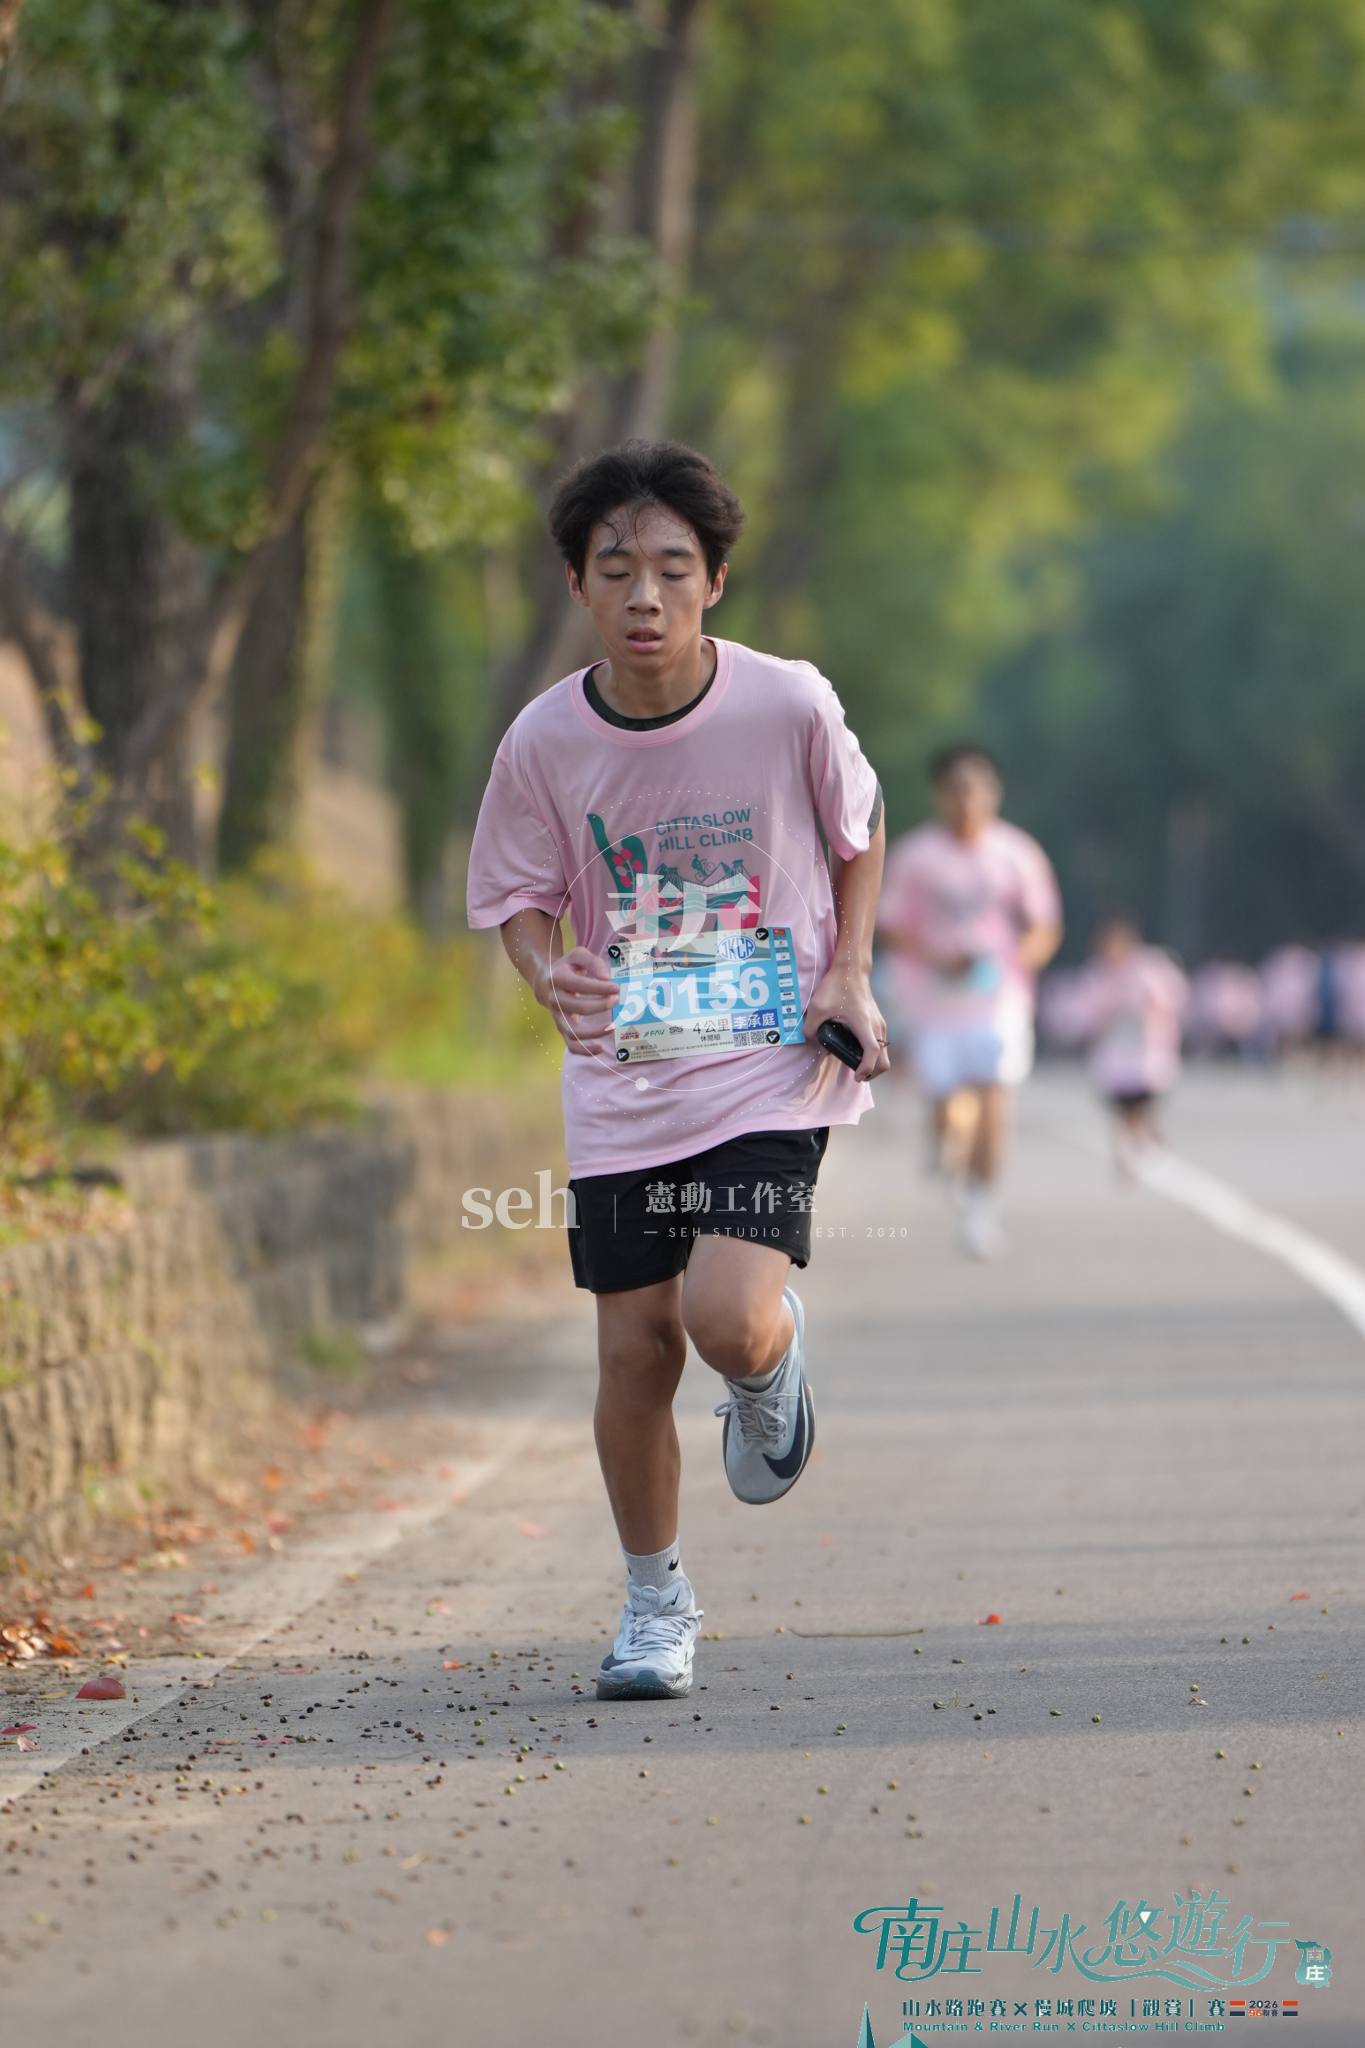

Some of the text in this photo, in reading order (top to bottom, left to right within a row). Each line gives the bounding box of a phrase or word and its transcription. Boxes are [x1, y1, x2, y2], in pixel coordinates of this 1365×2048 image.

[656, 808, 750, 836] CITTASLOW
[658, 828, 753, 852] HILL CLIMB
[618, 966, 770, 1021] 50156
